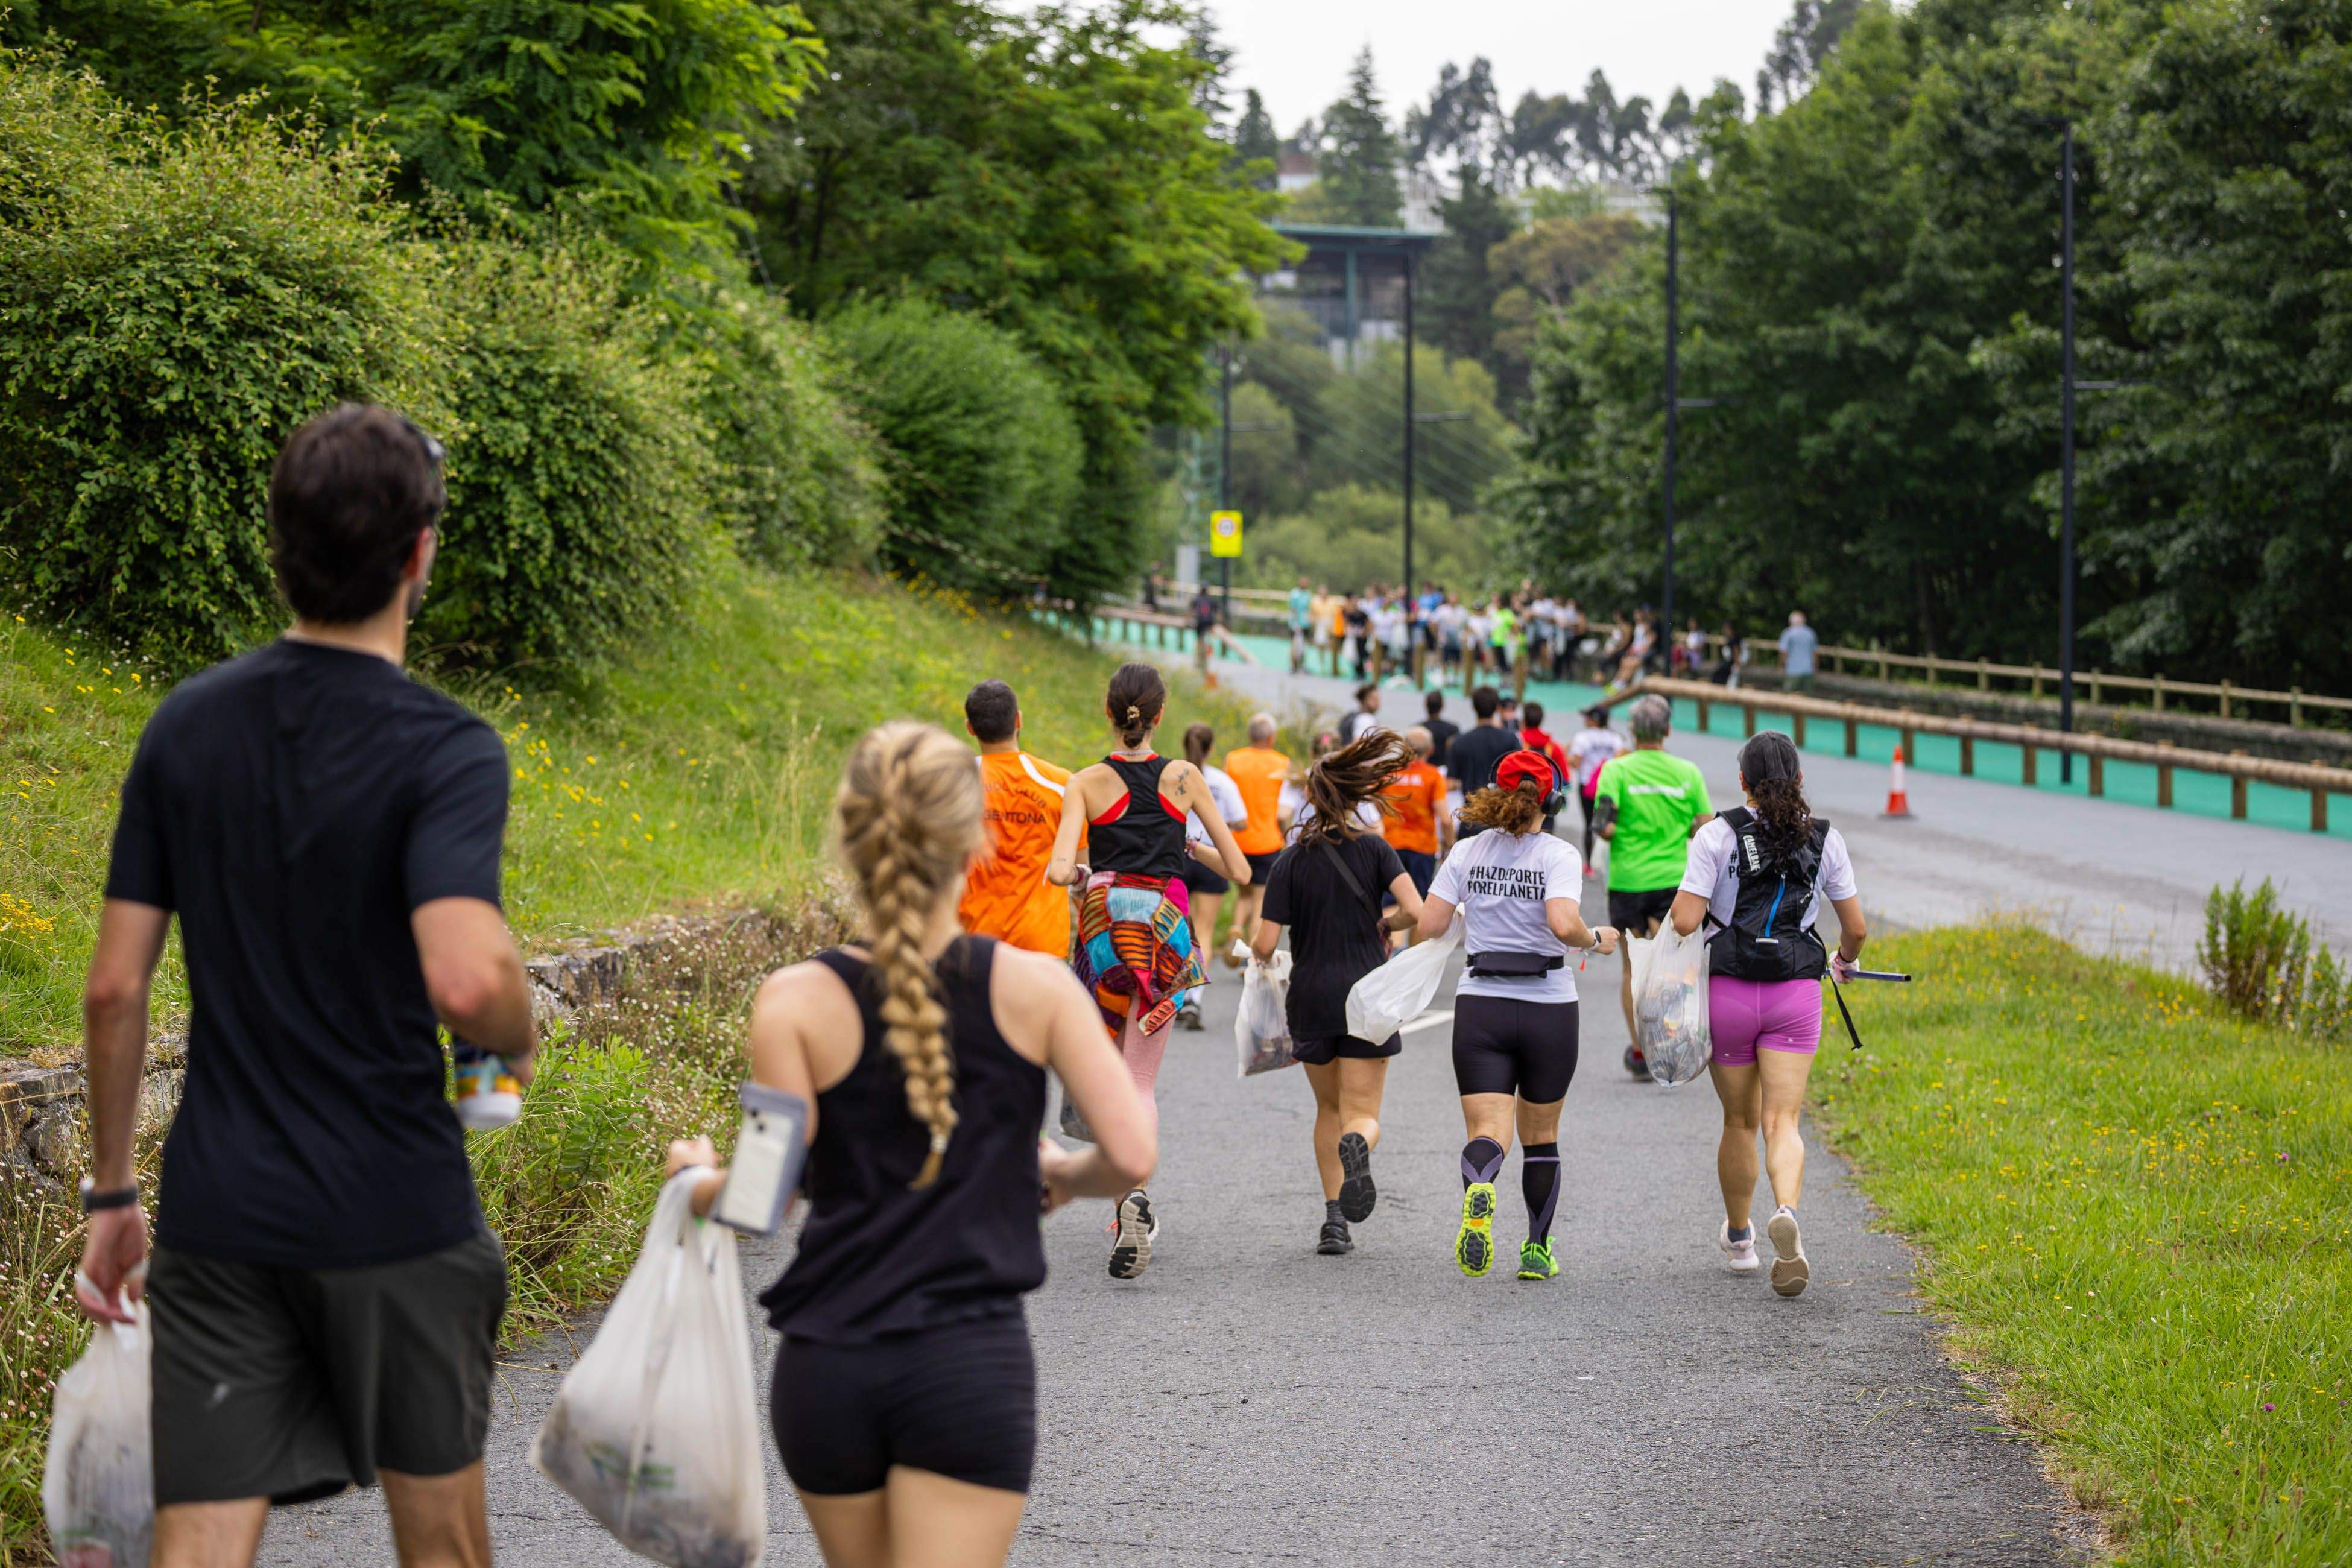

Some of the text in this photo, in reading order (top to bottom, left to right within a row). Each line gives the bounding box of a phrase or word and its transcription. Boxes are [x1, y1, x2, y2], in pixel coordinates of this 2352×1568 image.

[1015, 786, 1046, 809] CLUB
[984, 809, 1046, 825] GENTONA
[1469, 865, 1546, 885] #HAZDEPORTE
[1467, 880, 1546, 900] PORELPLANETA
